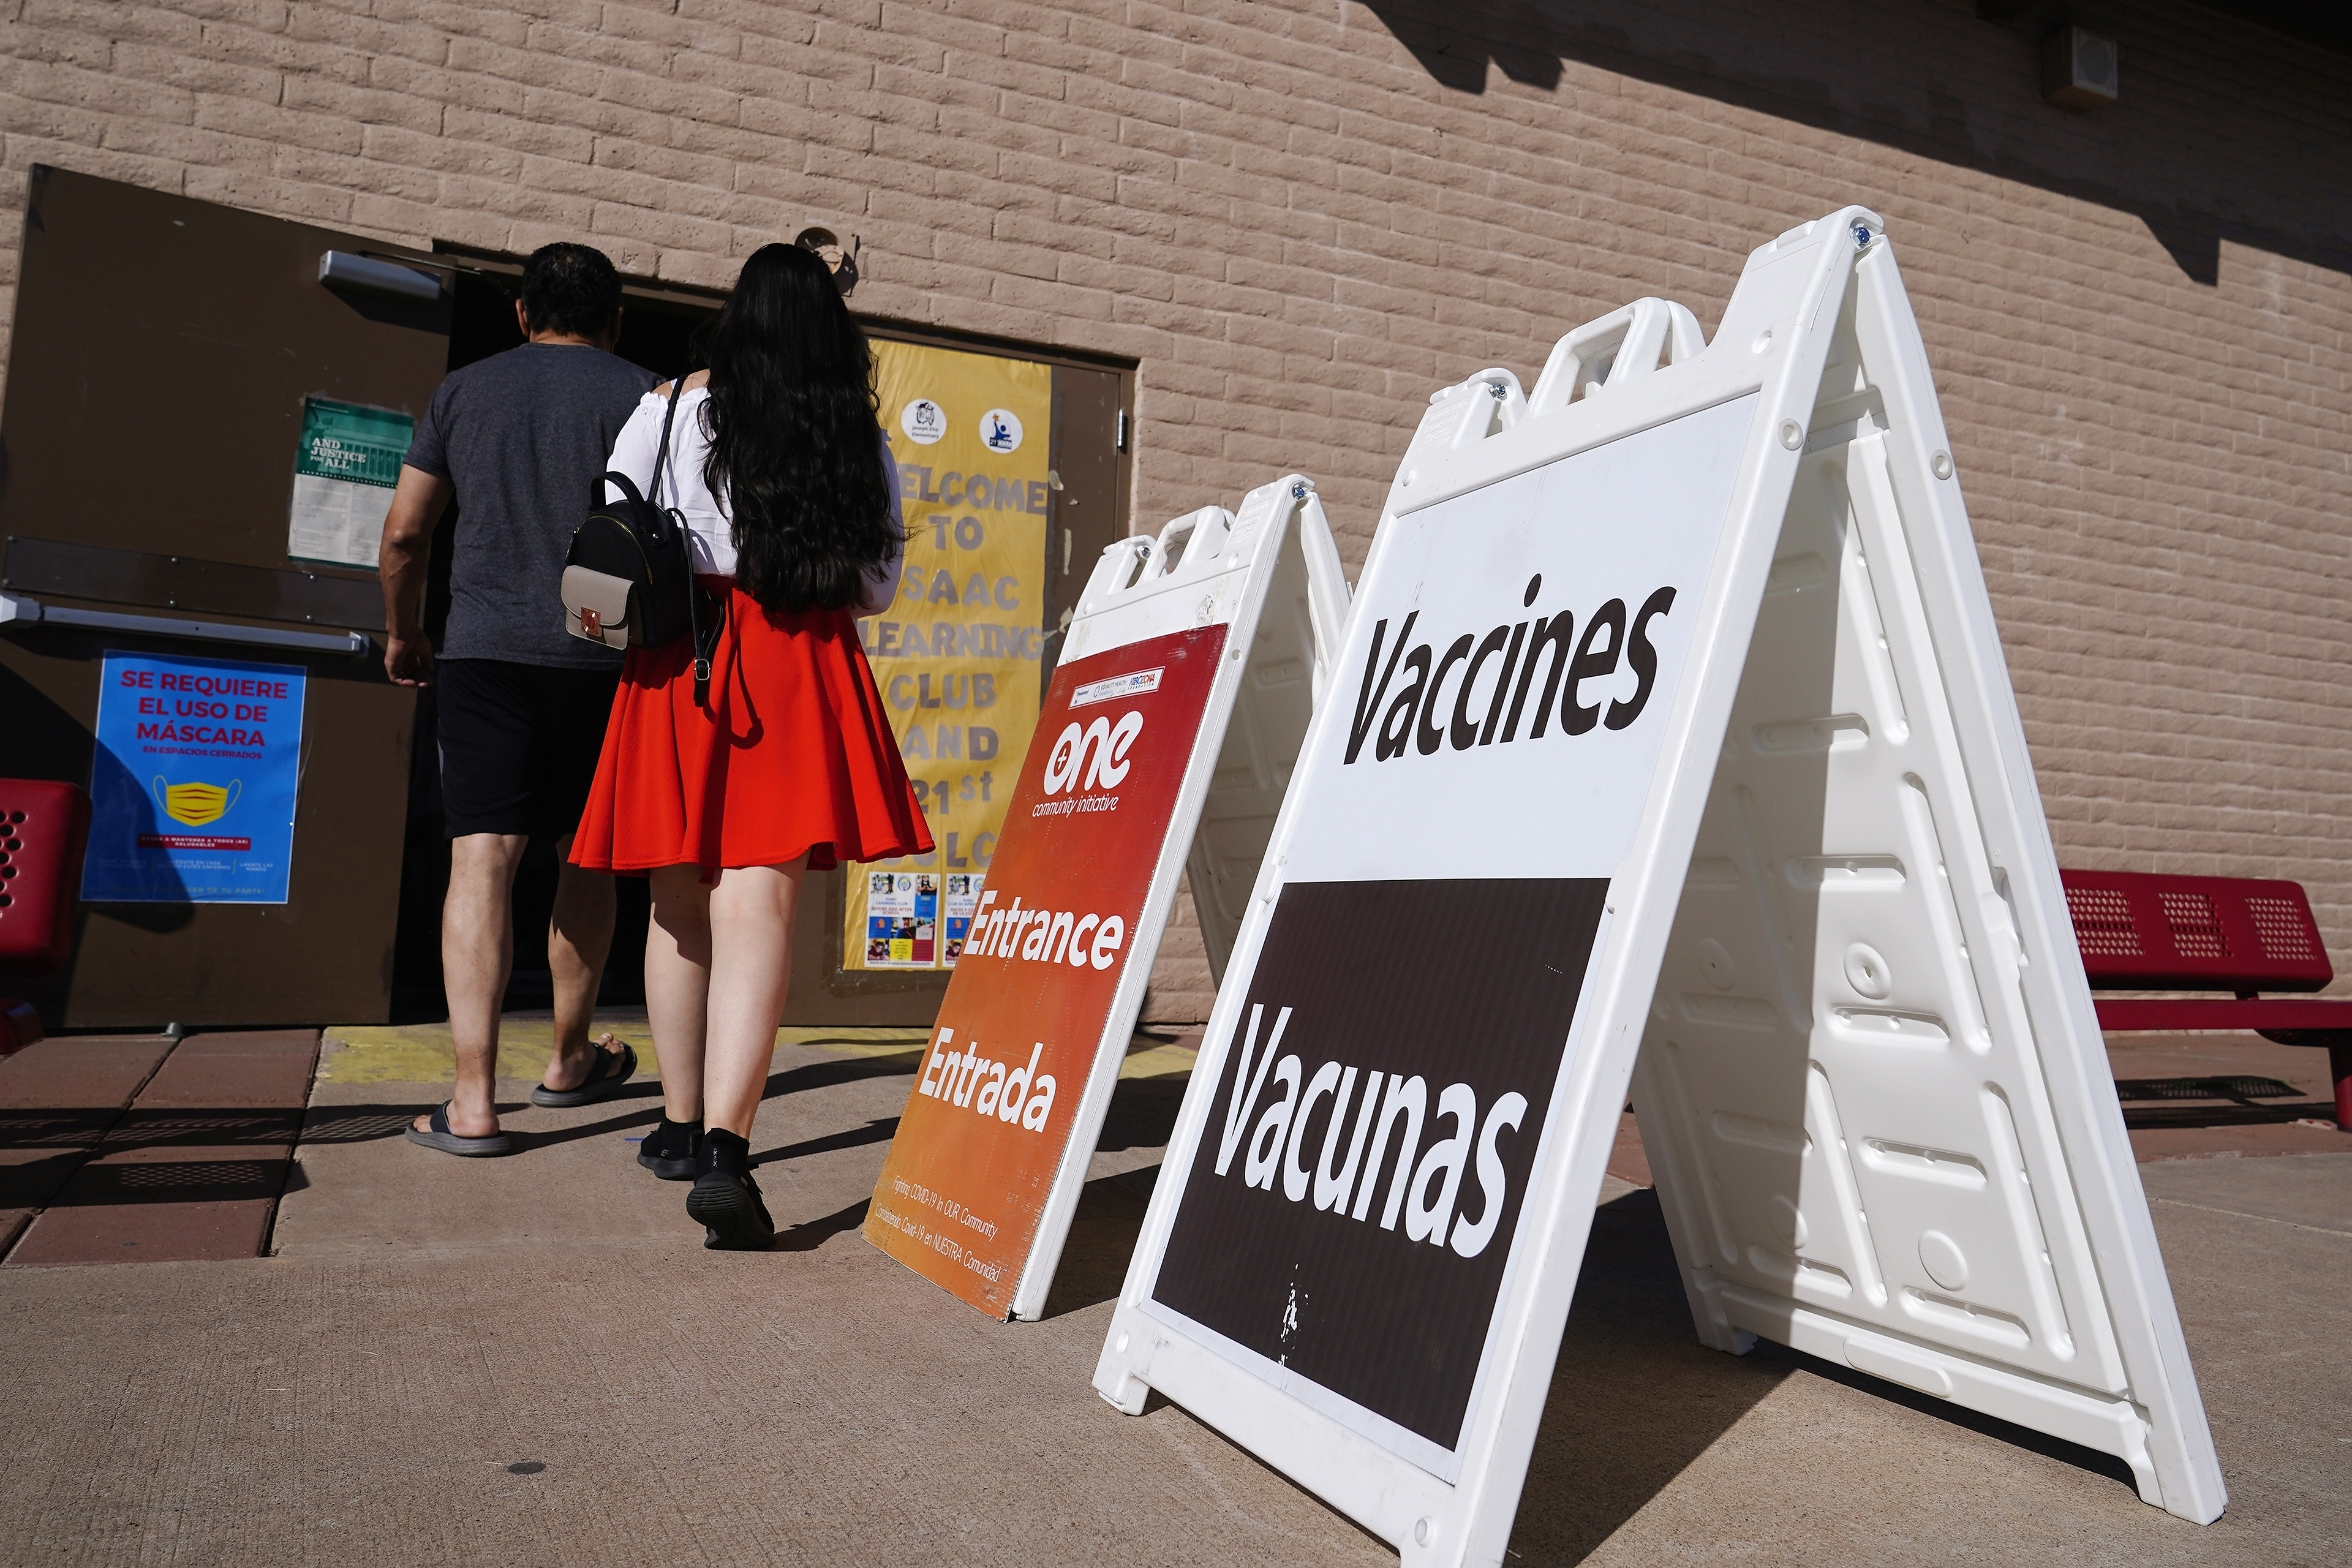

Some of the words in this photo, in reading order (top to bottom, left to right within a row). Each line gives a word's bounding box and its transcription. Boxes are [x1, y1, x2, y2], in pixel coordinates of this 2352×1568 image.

[311, 447, 366, 463] JUSTICE
[312, 437, 341, 450] AND
[325, 458, 350, 470] ALL
[896, 464, 1048, 516] ELCOME
[928, 516, 984, 551] TO
[902, 565, 1020, 611] SAAC
[858, 620, 1044, 661] LEARNING
[121, 670, 154, 688] SE
[160, 673, 287, 698] REQUIERE
[1343, 573, 1677, 765] Vaccines
[138, 697, 169, 715] EL
[175, 700, 228, 719] USO
[235, 704, 267, 722] DE
[889, 673, 997, 710] CLUB
[137, 720, 265, 747] MÁSCARA
[901, 724, 999, 761] AND
[159, 747, 208, 756] ESPACIOS
[209, 749, 262, 759] CERRADOS
[1044, 710, 1144, 796] one
[1032, 796, 1076, 818] community
[1076, 793, 1119, 813] initiative
[963, 890, 1125, 970] Entrance
[919, 1027, 1057, 1133] Entrada
[1214, 1003, 1528, 1258] Vacunas
[892, 1175, 910, 1199] Fighting
[910, 1184, 937, 1207] COVID-19
[944, 1200, 960, 1220] OUR
[960, 1208, 998, 1242] Community
[875, 1202, 901, 1228] Combatiendo
[902, 1217, 925, 1240] Covid-19
[924, 1234, 932, 1246] en
[932, 1234, 963, 1263] NUESTRA
[963, 1251, 1001, 1282] Comunidad
